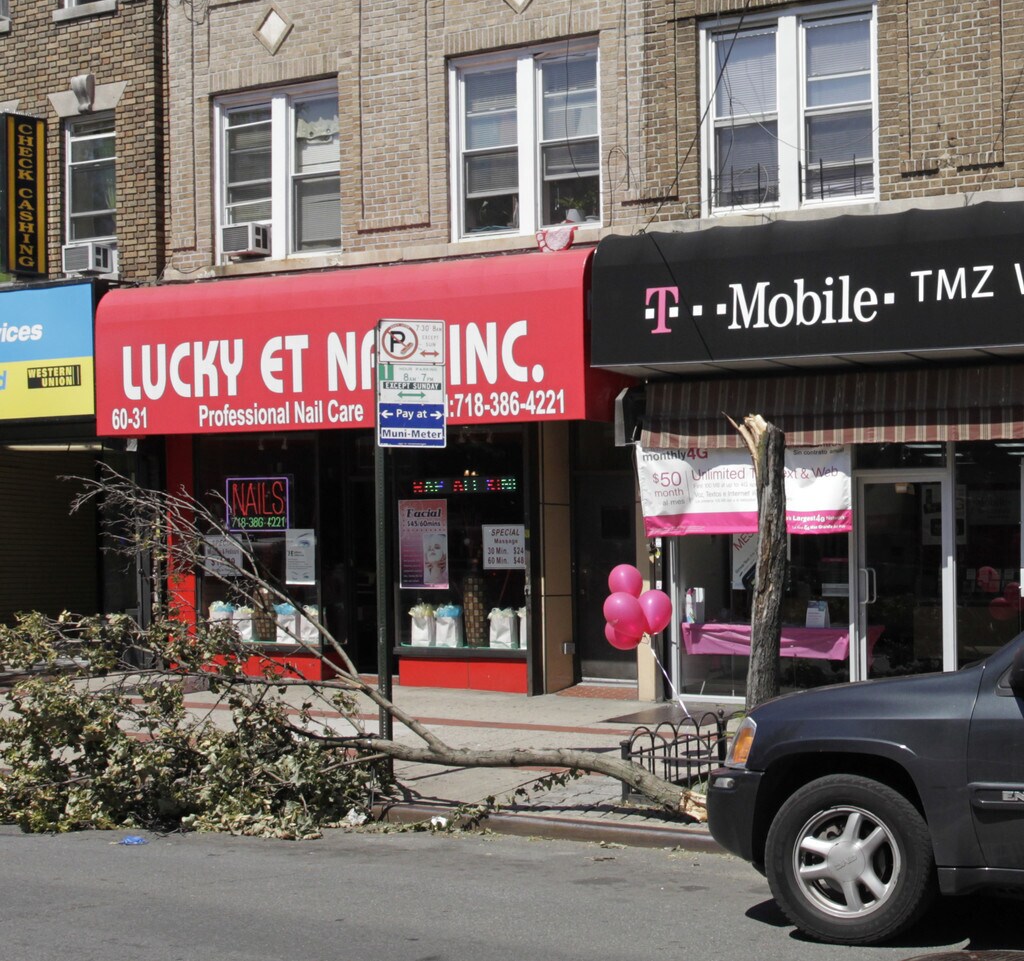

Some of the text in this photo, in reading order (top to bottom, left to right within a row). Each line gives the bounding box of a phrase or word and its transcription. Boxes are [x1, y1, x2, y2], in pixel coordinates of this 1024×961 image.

[17, 123, 35, 267] CHECK CASHING
[910, 265, 994, 302] TMZ
[122, 338, 244, 400] LUCKY
[260, 334, 309, 394] ET
[449, 320, 545, 386] INC.
[28, 366, 73, 379] WESTERN
[41, 376, 73, 387] UNION
[112, 406, 147, 430] 60-31
[199, 398, 364, 427] Professional Nail Care
[396, 408, 427, 420] Pay at
[382, 429, 442, 439] Muni-Meter
[652, 471, 682, 488] $50
[691, 467, 746, 481] Unlimited
[784, 466, 839, 480] ext & Web
[232, 481, 285, 516] NAILS
[654, 488, 684, 498] month
[406, 508, 442, 518] Facial
[231, 516, 286, 528] 718-386-4221
[491, 528, 520, 537] SPECIAL
[487, 547, 495, 555] 30
[487, 556, 495, 565] 60
